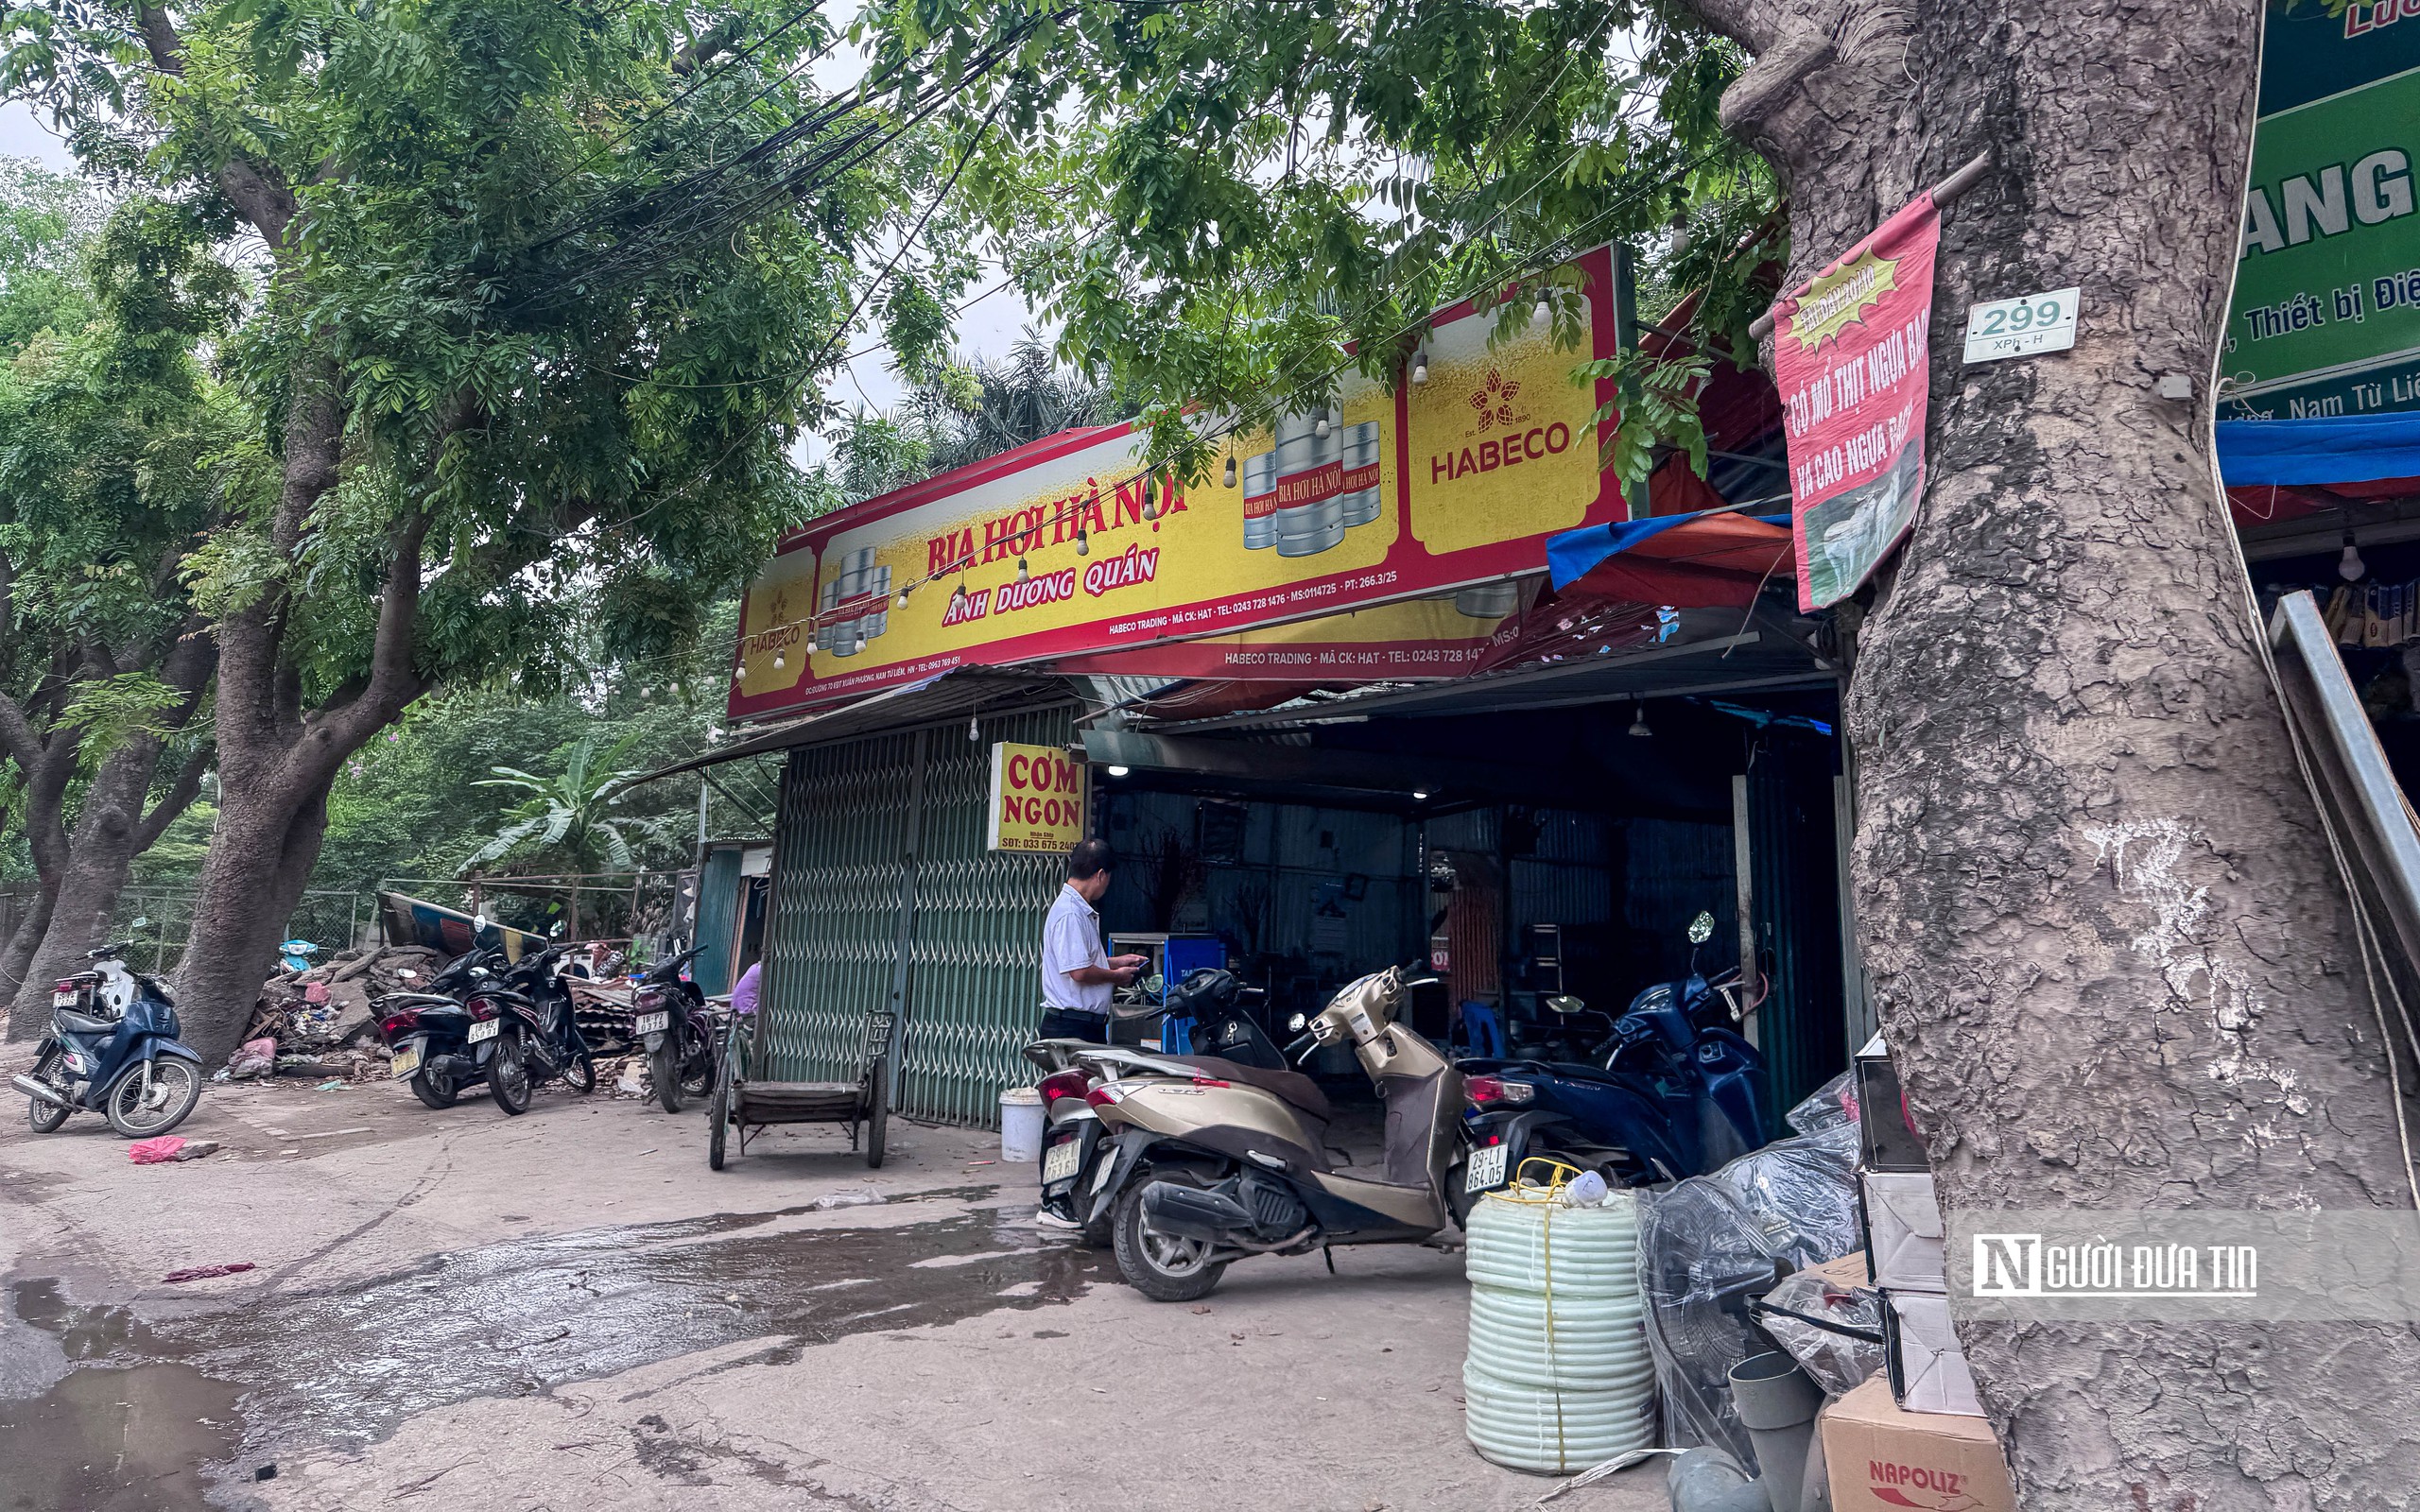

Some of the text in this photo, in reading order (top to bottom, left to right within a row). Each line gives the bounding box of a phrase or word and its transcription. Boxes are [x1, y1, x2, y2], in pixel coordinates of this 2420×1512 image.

[1981, 301, 2061, 335] 299
[2243, 292, 2325, 341] Thiết
[2332, 284, 2364, 323] bị
[1790, 379, 1809, 438] CÓ
[1834, 355, 1866, 415] THỊT
[1868, 331, 1907, 394] NGỰA
[2290, 394, 2343, 420] Nam
[2351, 382, 2382, 410] Từ
[1514, 414, 1530, 424] 1890
[1431, 421, 1569, 485] HABECO
[1796, 452, 1814, 501] VÀ
[1814, 445, 1844, 490] CAO
[1846, 421, 1888, 472] NGỰA
[1278, 484, 1291, 503] BIA
[1293, 480, 1310, 500] HƠI
[1311, 471, 1325, 496] HÀ
[1326, 466, 1341, 492] NỘI
[927, 526, 977, 578] BIA
[981, 502, 1046, 566] HƠI
[1051, 477, 1107, 545] HÀ
[994, 568, 1076, 615] DƯƠNG
[1083, 542, 1160, 597] QUÁN
[1109, 570, 1397, 635] HABECO TRADING MÃ CK: HAT TEL: 0243 728 1476 MS:0114725 PT: 266.3/25
[750, 626, 800, 655] HABECO
[1225, 652, 1266, 664] HABECO
[1268, 652, 1312, 664] TRADING
[1320, 649, 1337, 664] MÃ
[1338, 652, 1356, 663] CK:
[1358, 652, 1379, 663] HAT
[1388, 651, 1409, 662] TEL:
[1412, 649, 1440, 662] 0243
[1443, 649, 1462, 662] 728
[1008, 750, 1078, 794] CƠM
[1003, 795, 1080, 828] NGON
[1023, 838, 1039, 849] 033
[1042, 840, 1057, 850] 675
[1060, 841, 1078, 850] 240
[1473, 1147, 1501, 1170] 29-L1
[1468, 1165, 1502, 1190] 864.05
[1869, 1460, 1961, 1494] NAPOLIZ
